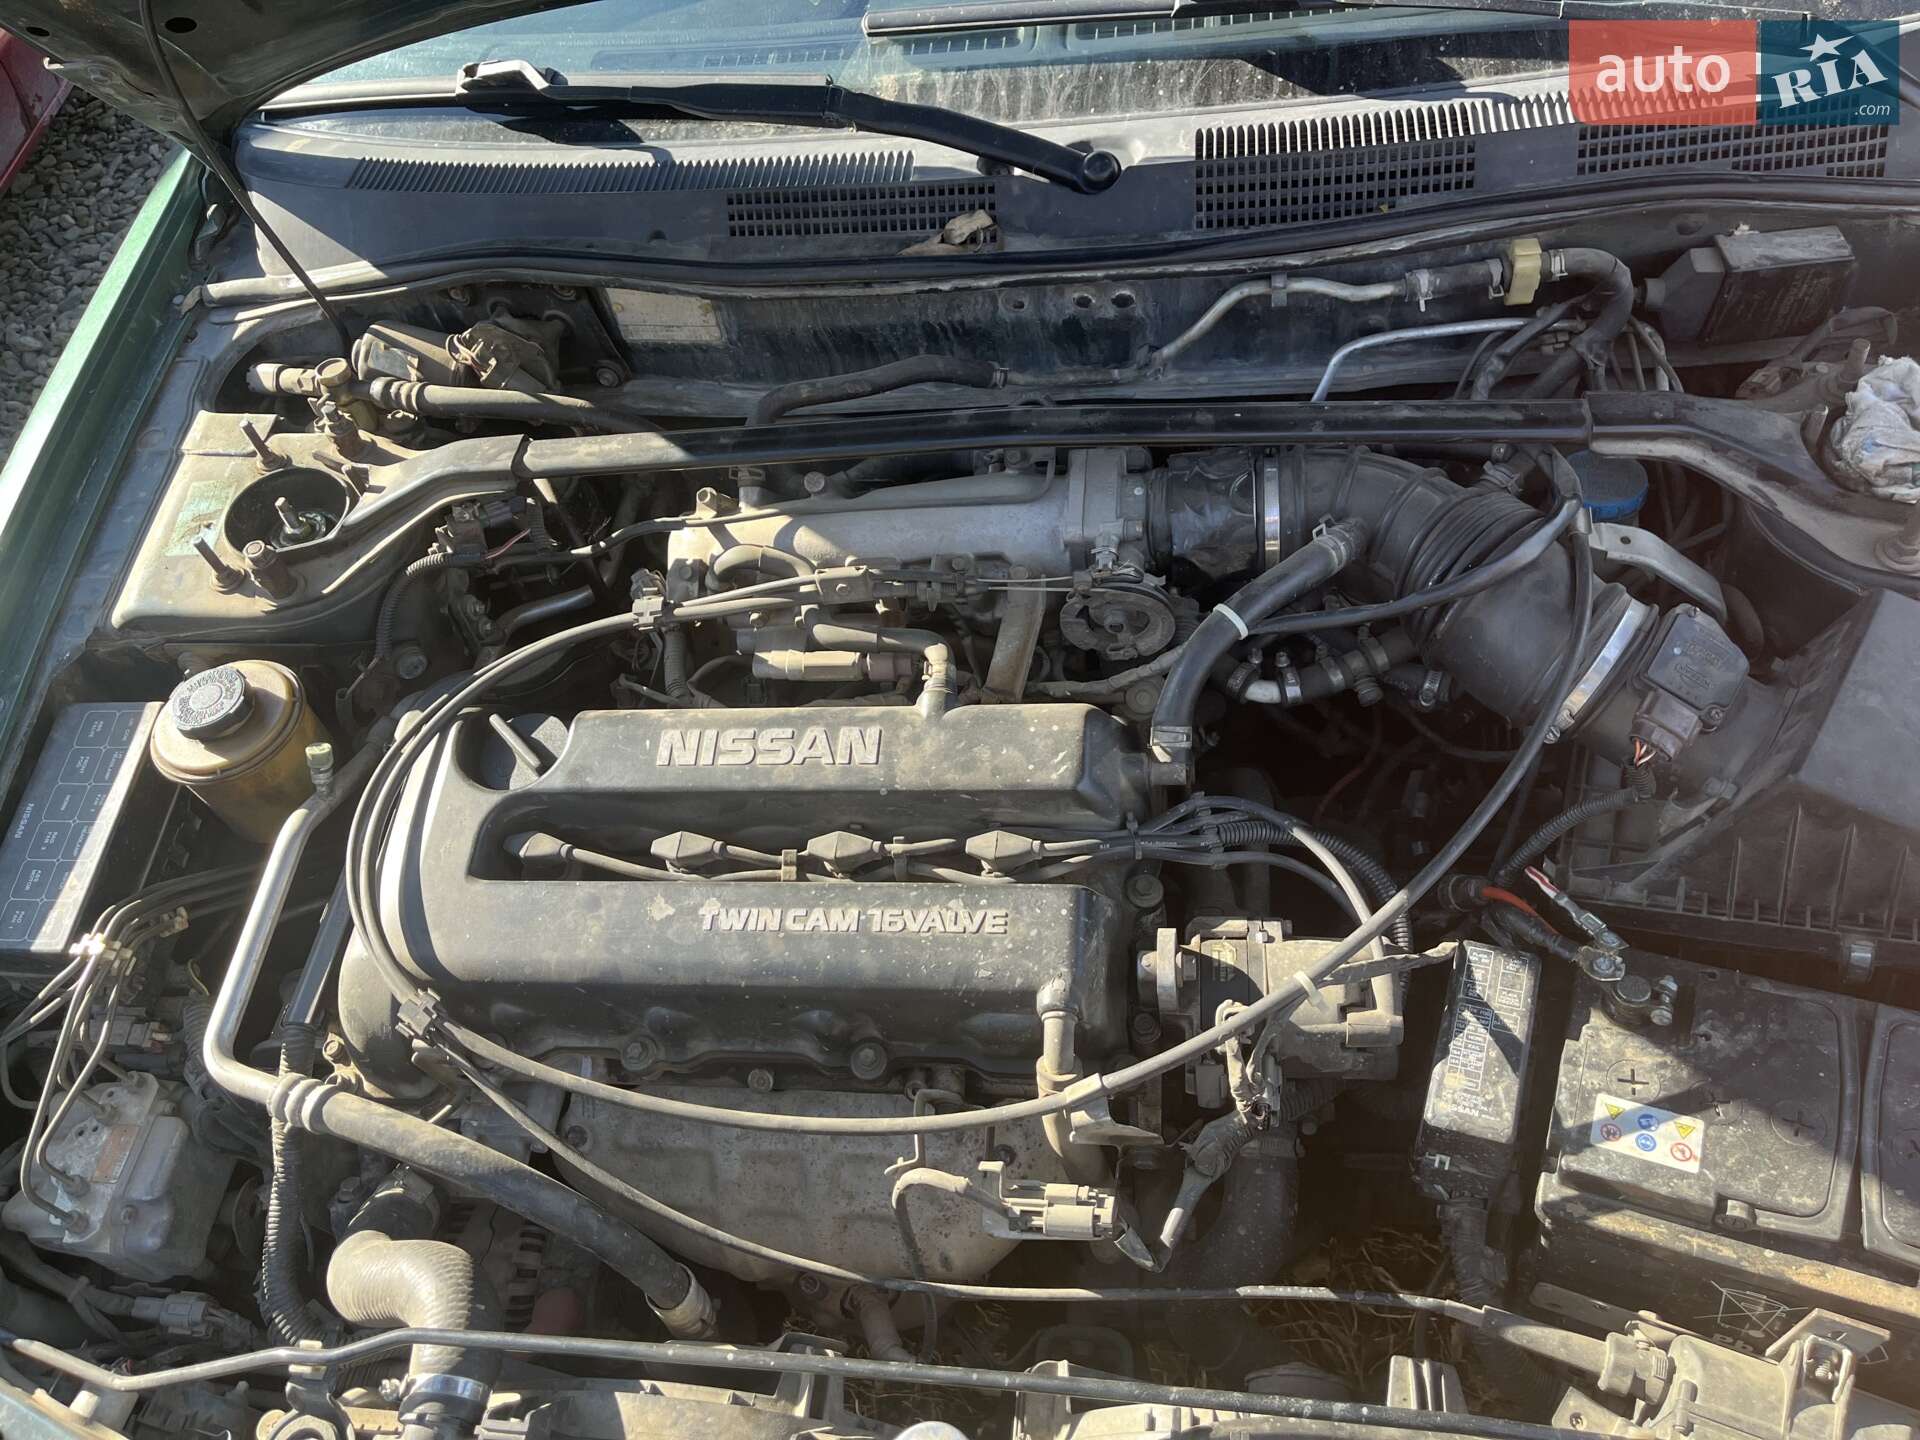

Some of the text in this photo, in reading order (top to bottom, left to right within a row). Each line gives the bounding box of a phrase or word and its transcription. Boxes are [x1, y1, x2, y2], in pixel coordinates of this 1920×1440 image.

[656, 726, 883, 766] NISSAN
[700, 907, 1009, 934] TWIN CAM 16VALVE
